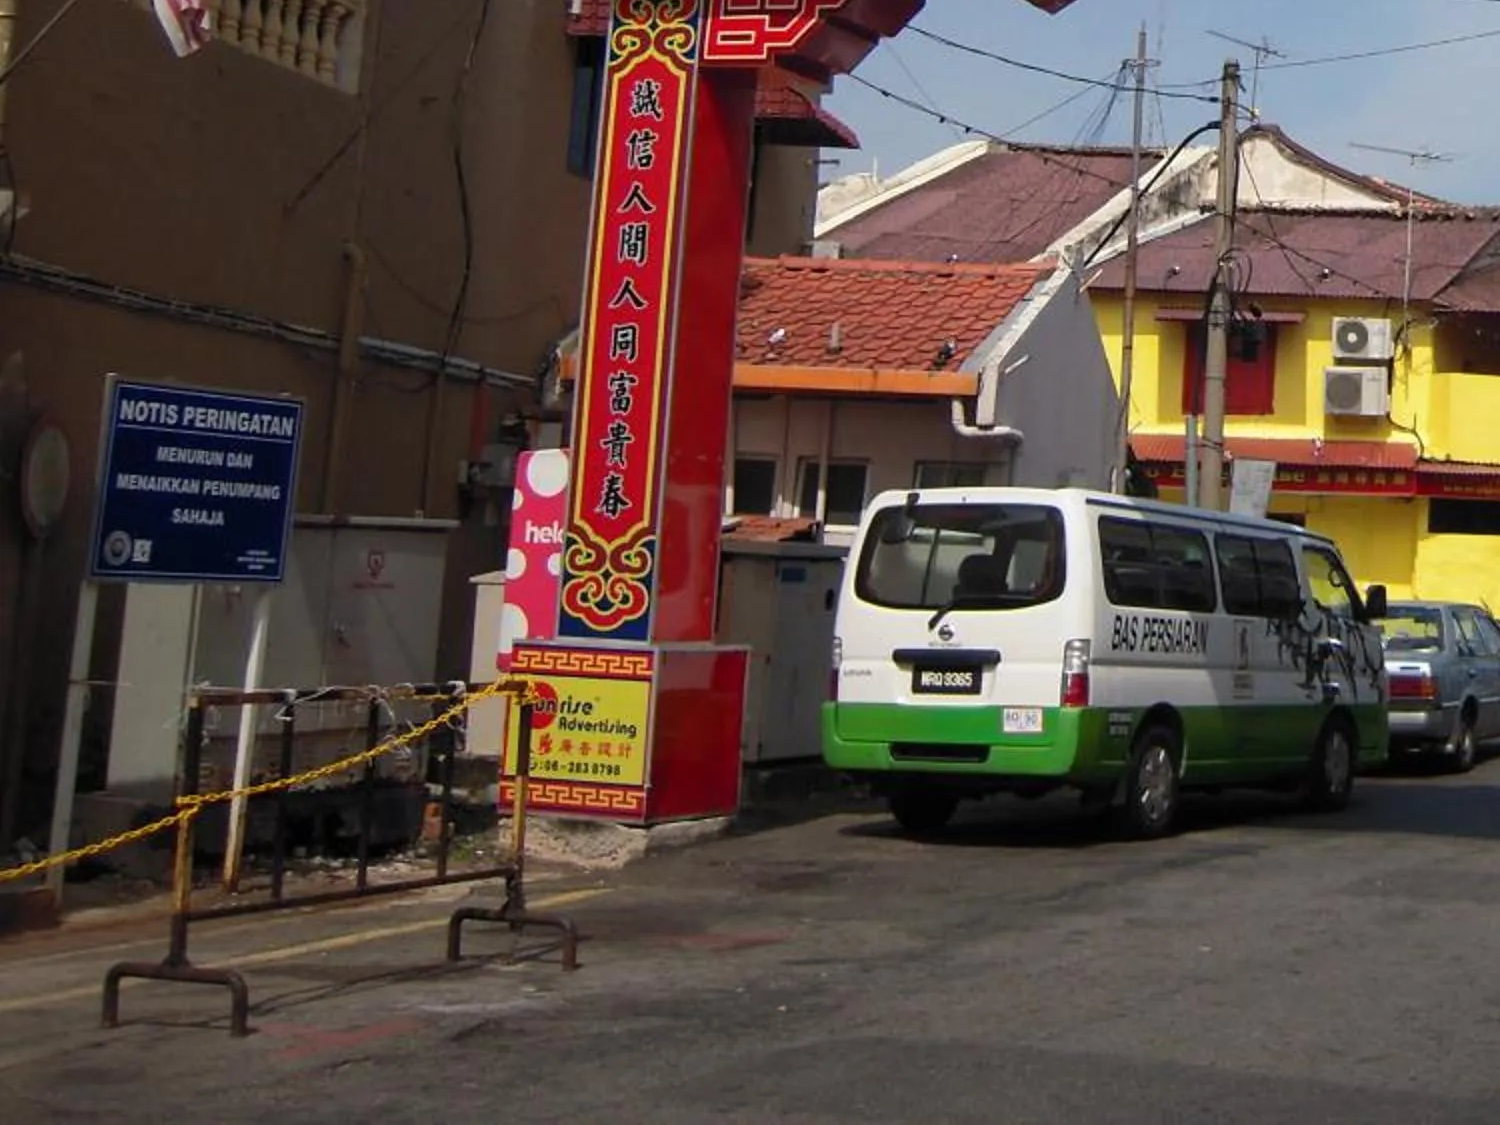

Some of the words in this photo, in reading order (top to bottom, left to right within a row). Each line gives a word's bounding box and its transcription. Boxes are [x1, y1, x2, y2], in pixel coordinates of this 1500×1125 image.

[595, 78, 664, 519] 誠信人間人同富貴春
[119, 398, 179, 425] NOTIS
[182, 406, 294, 436] PERINGATAN
[156, 446, 224, 467] MENURUN
[226, 452, 254, 469] DAN
[116, 472, 200, 495] MENAIKKAN
[202, 480, 281, 501] PENUMPANG
[171, 507, 225, 526] SAHAJA
[1111, 614, 1138, 652] BAS
[1140, 616, 1209, 655] PERSIARAN
[534, 694, 594, 716] unrise
[558, 717, 637, 740] Advertising
